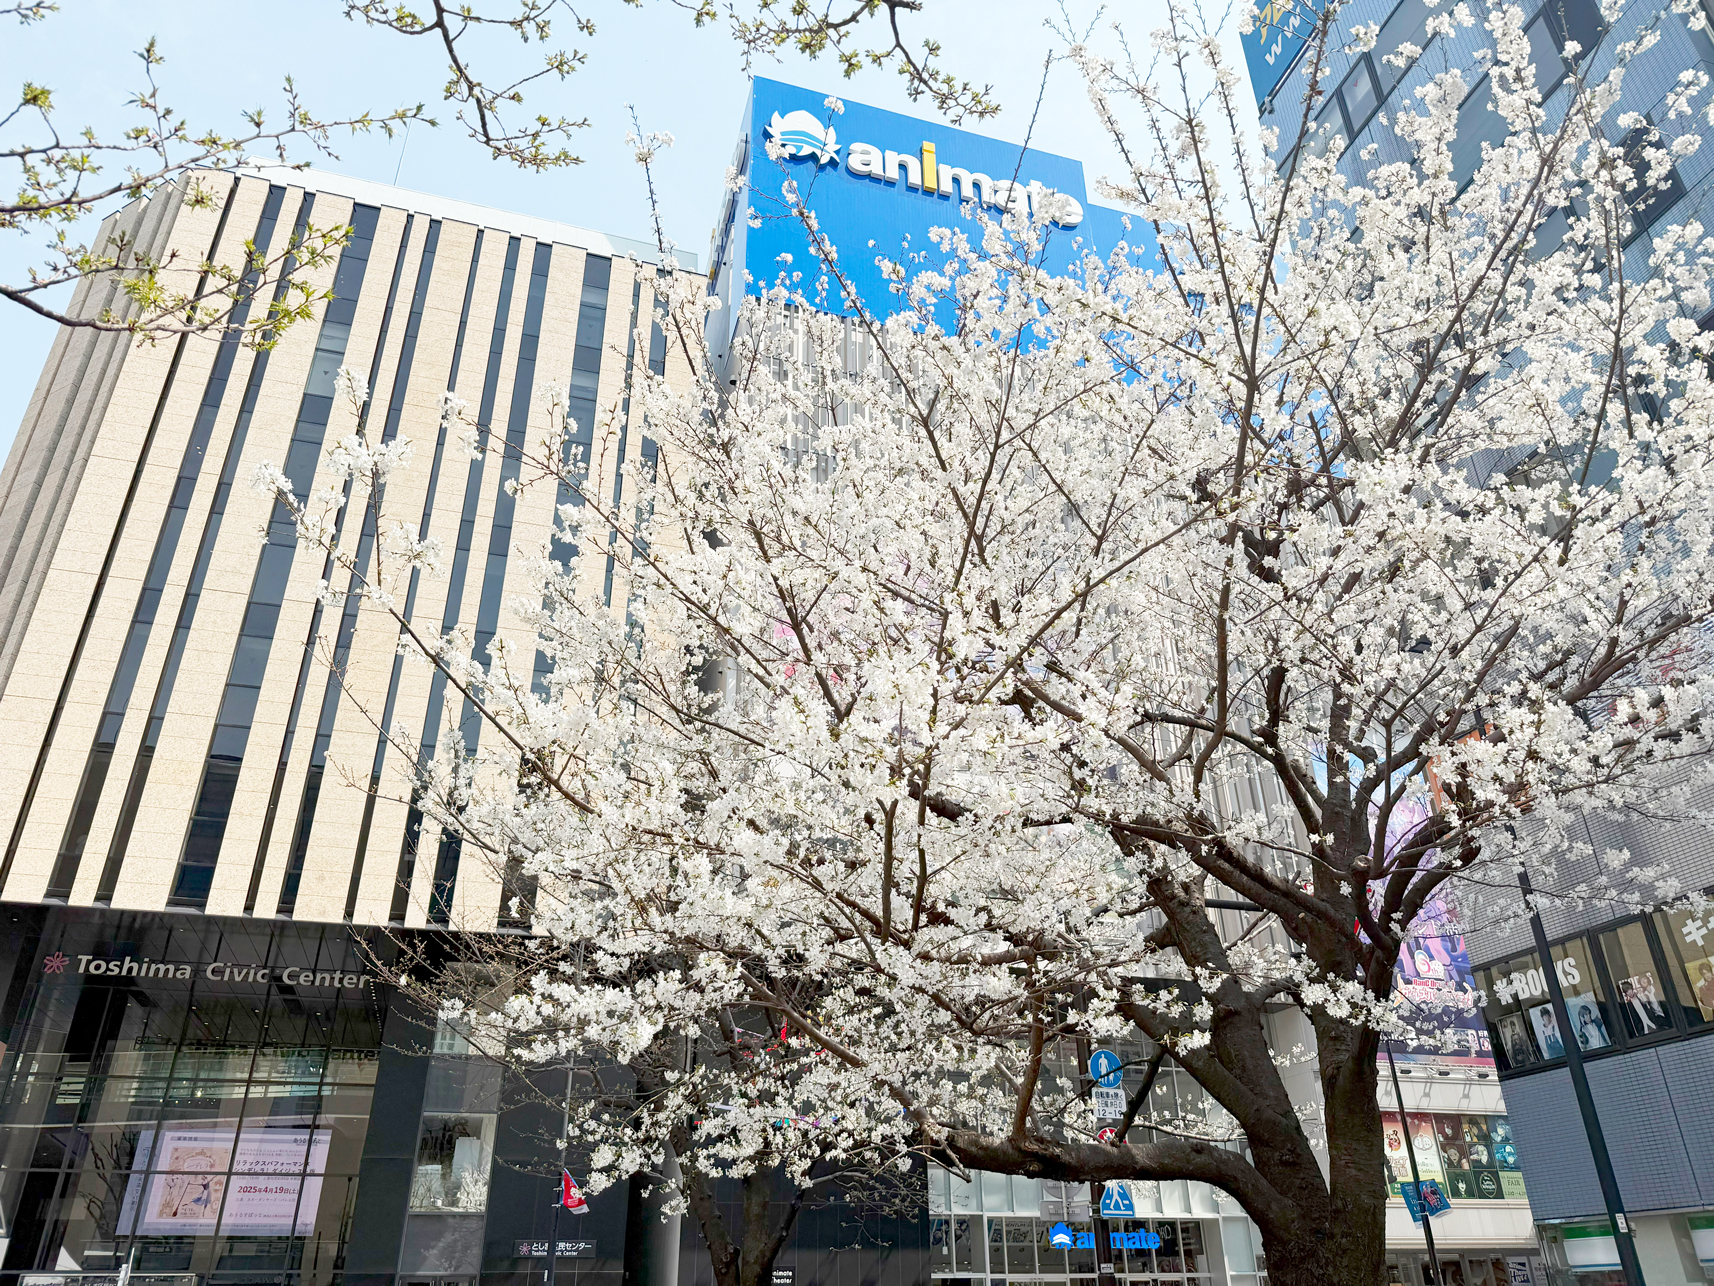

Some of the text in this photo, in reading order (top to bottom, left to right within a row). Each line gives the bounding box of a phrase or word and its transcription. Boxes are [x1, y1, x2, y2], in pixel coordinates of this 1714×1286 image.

[847, 140, 1084, 228] animate
[77, 955, 370, 989] Toshima Civic Center
[1495, 956, 1581, 1006] KBOKS
[1095, 1090, 1123, 1100] 自転車を除く
[1097, 1108, 1123, 1118] 12-19
[1076, 1228, 1161, 1249] anmate
